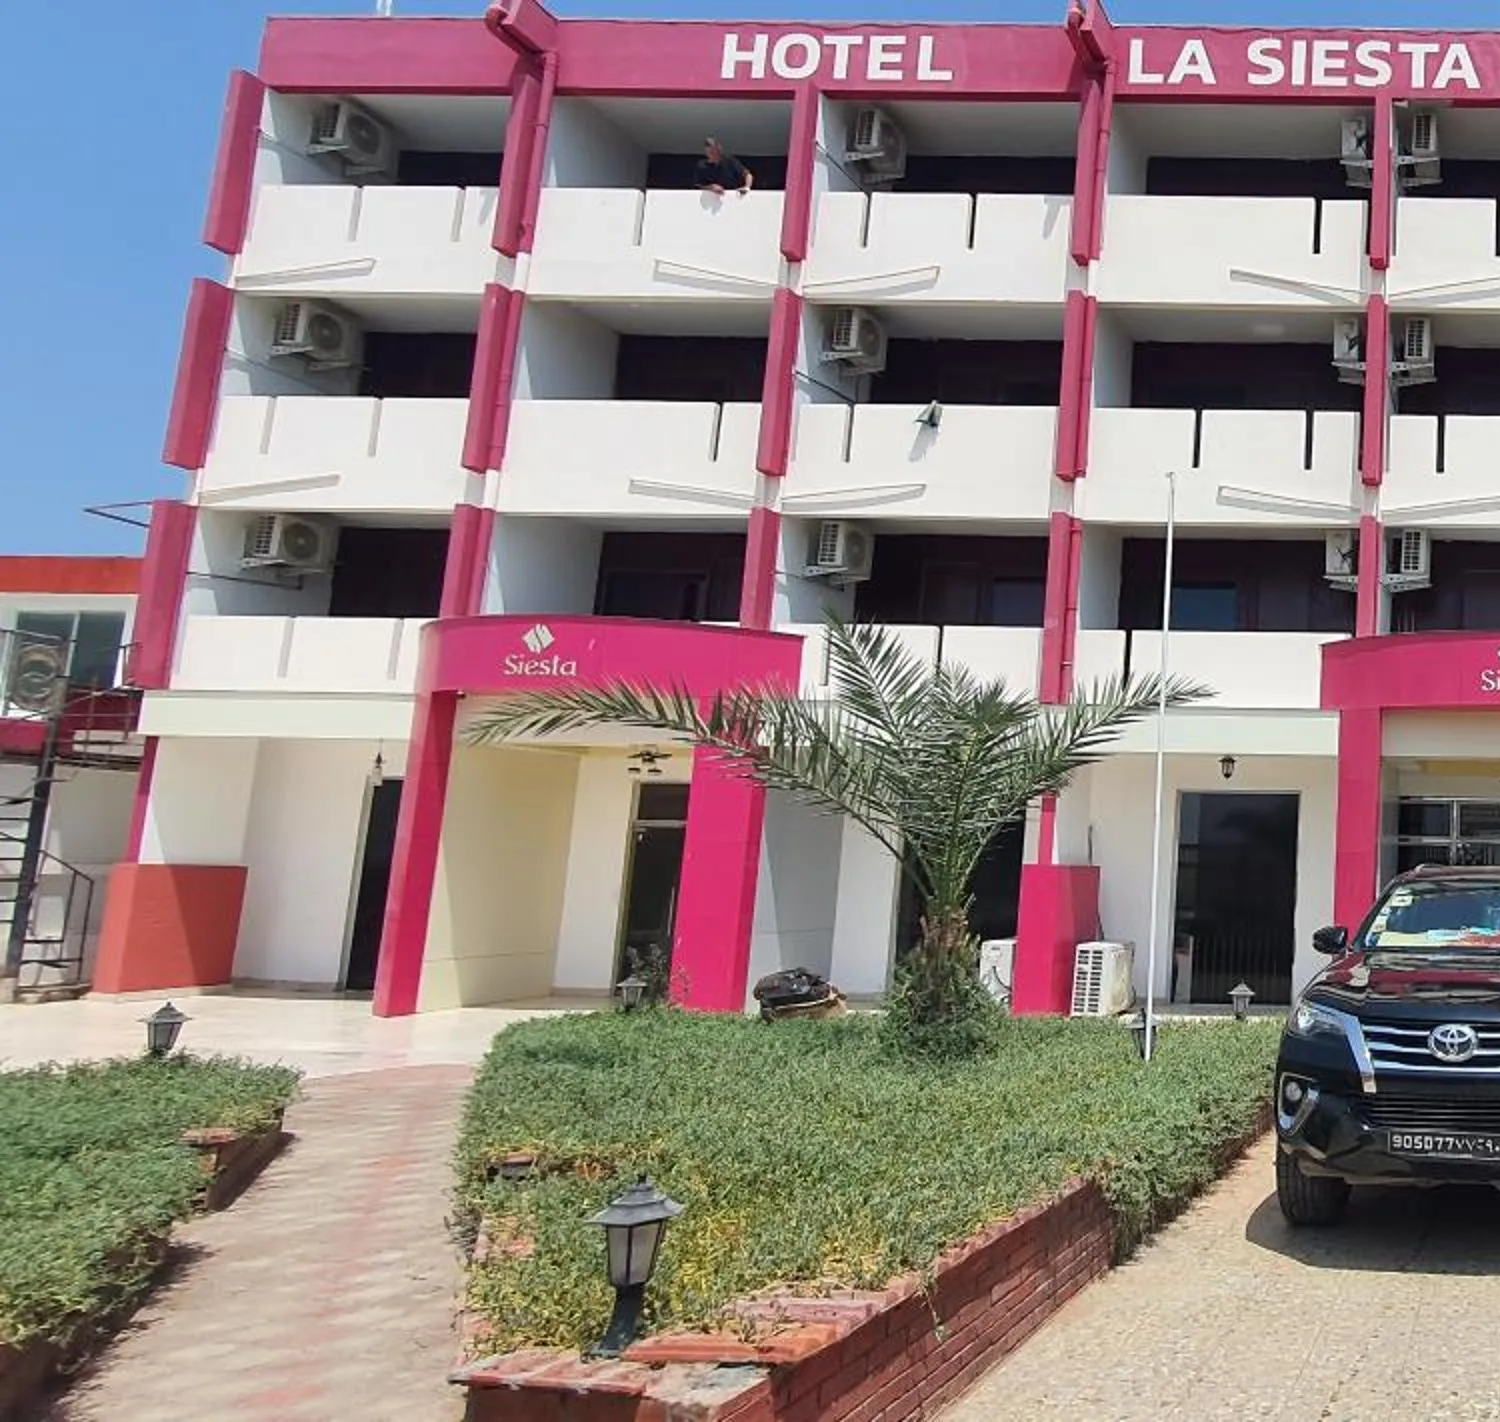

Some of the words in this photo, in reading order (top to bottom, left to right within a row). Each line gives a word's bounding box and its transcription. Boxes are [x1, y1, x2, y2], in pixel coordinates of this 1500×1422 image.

[719, 33, 954, 81] HOTEL
[1127, 37, 1217, 86] LA
[1247, 37, 1482, 89] SIESTA
[504, 654, 577, 676] Siesta
